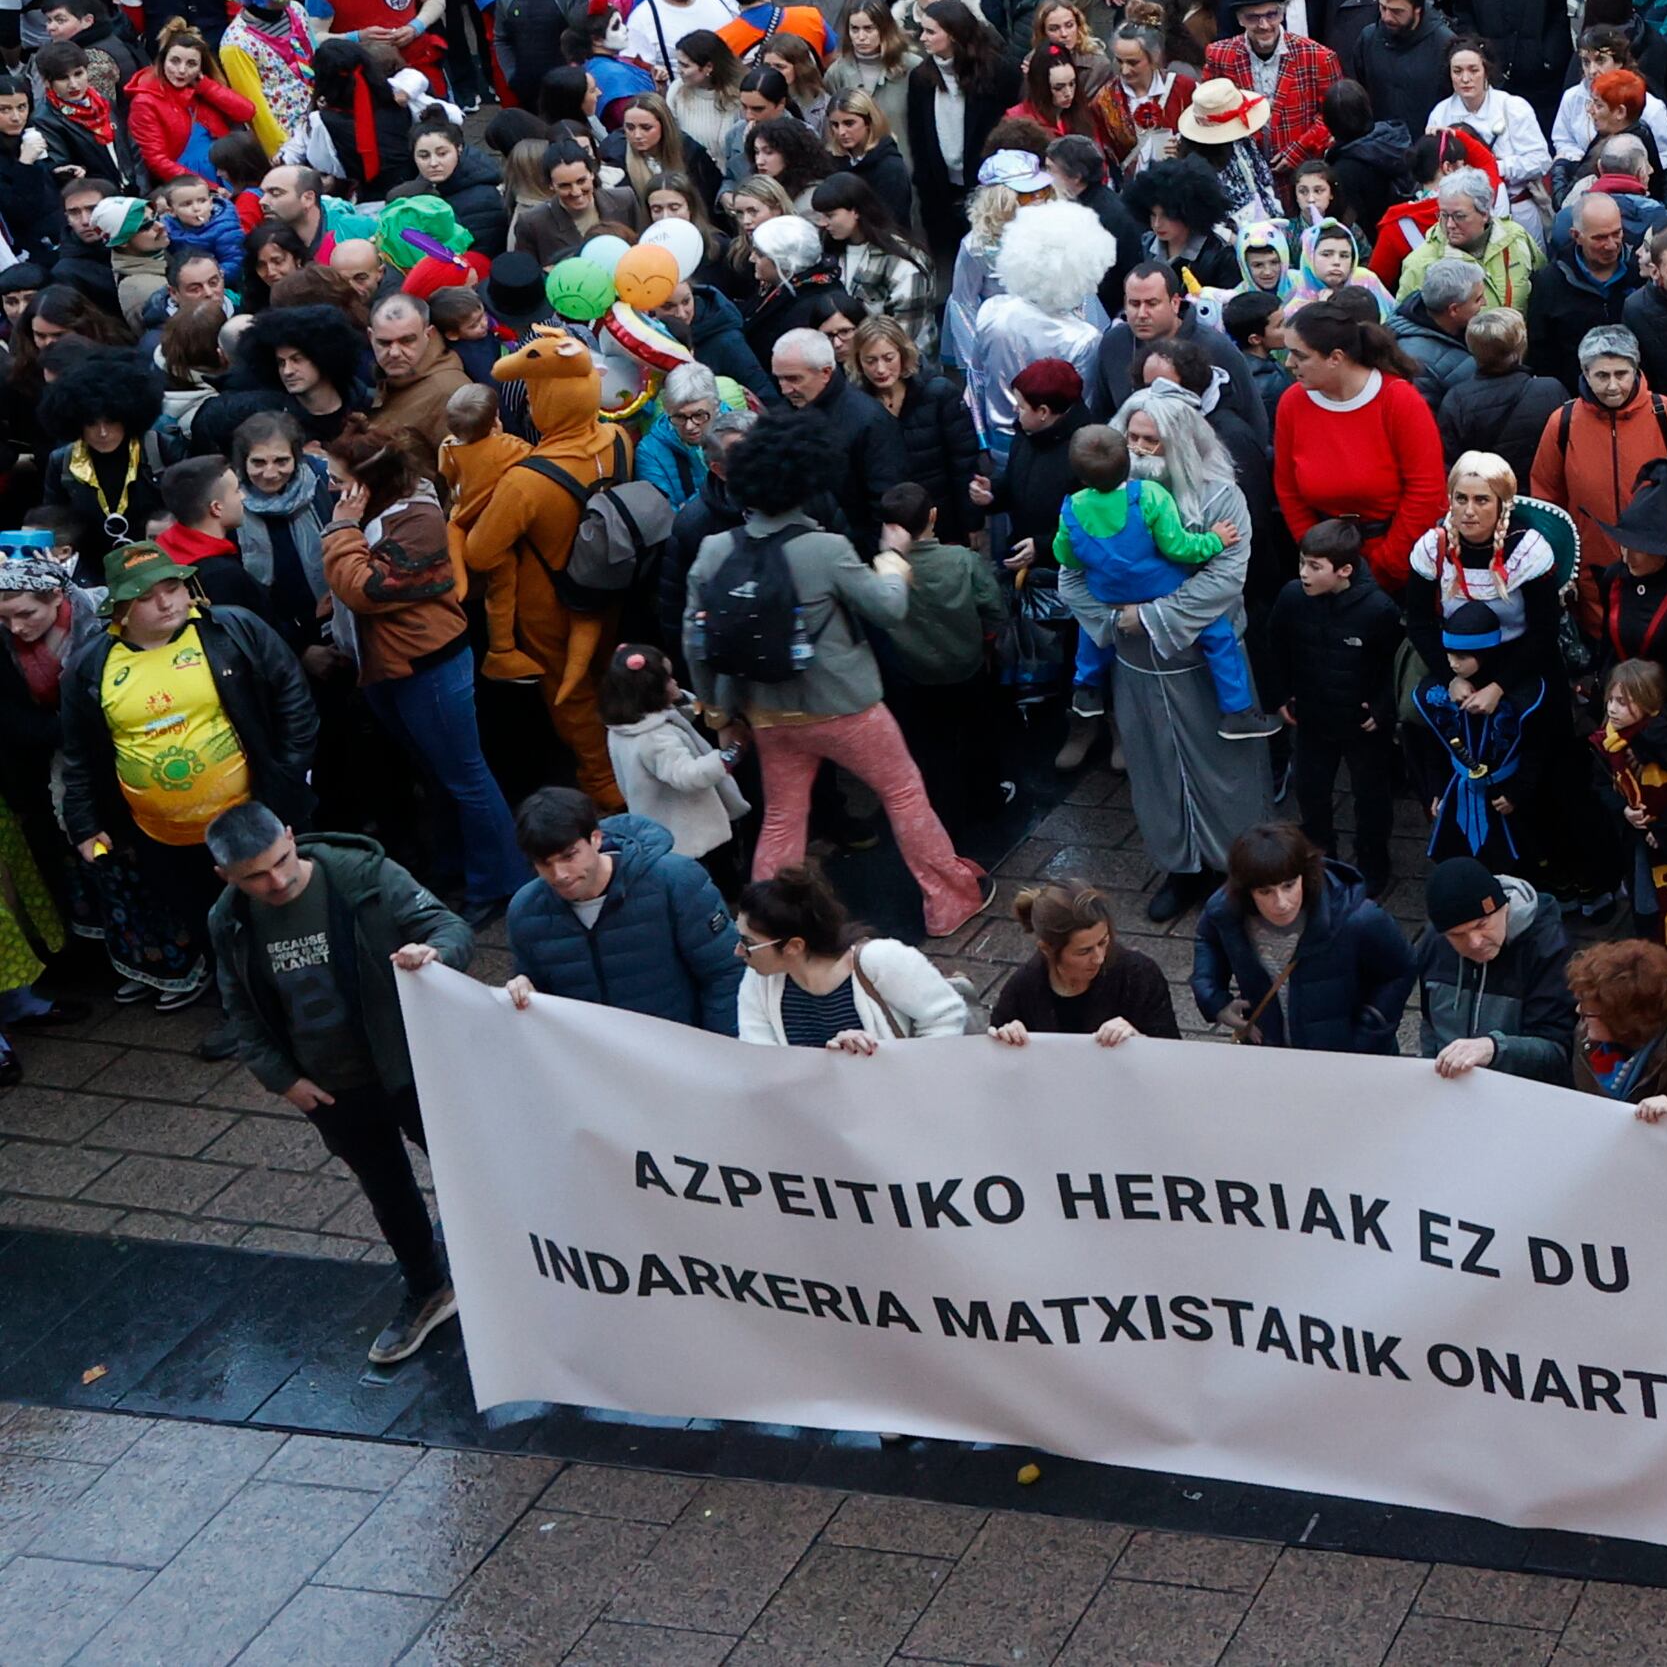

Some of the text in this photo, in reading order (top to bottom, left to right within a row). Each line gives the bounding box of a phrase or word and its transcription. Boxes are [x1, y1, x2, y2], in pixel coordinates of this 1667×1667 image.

[266, 932, 327, 954] BECAUSE
[272, 950, 331, 974] PLANET
[635, 1150, 1631, 1294] AZPEITIKO HERRIAK EZ DU
[528, 1232, 922, 1334] INDARKERIA
[935, 1294, 1410, 1382] MATXISTARIK
